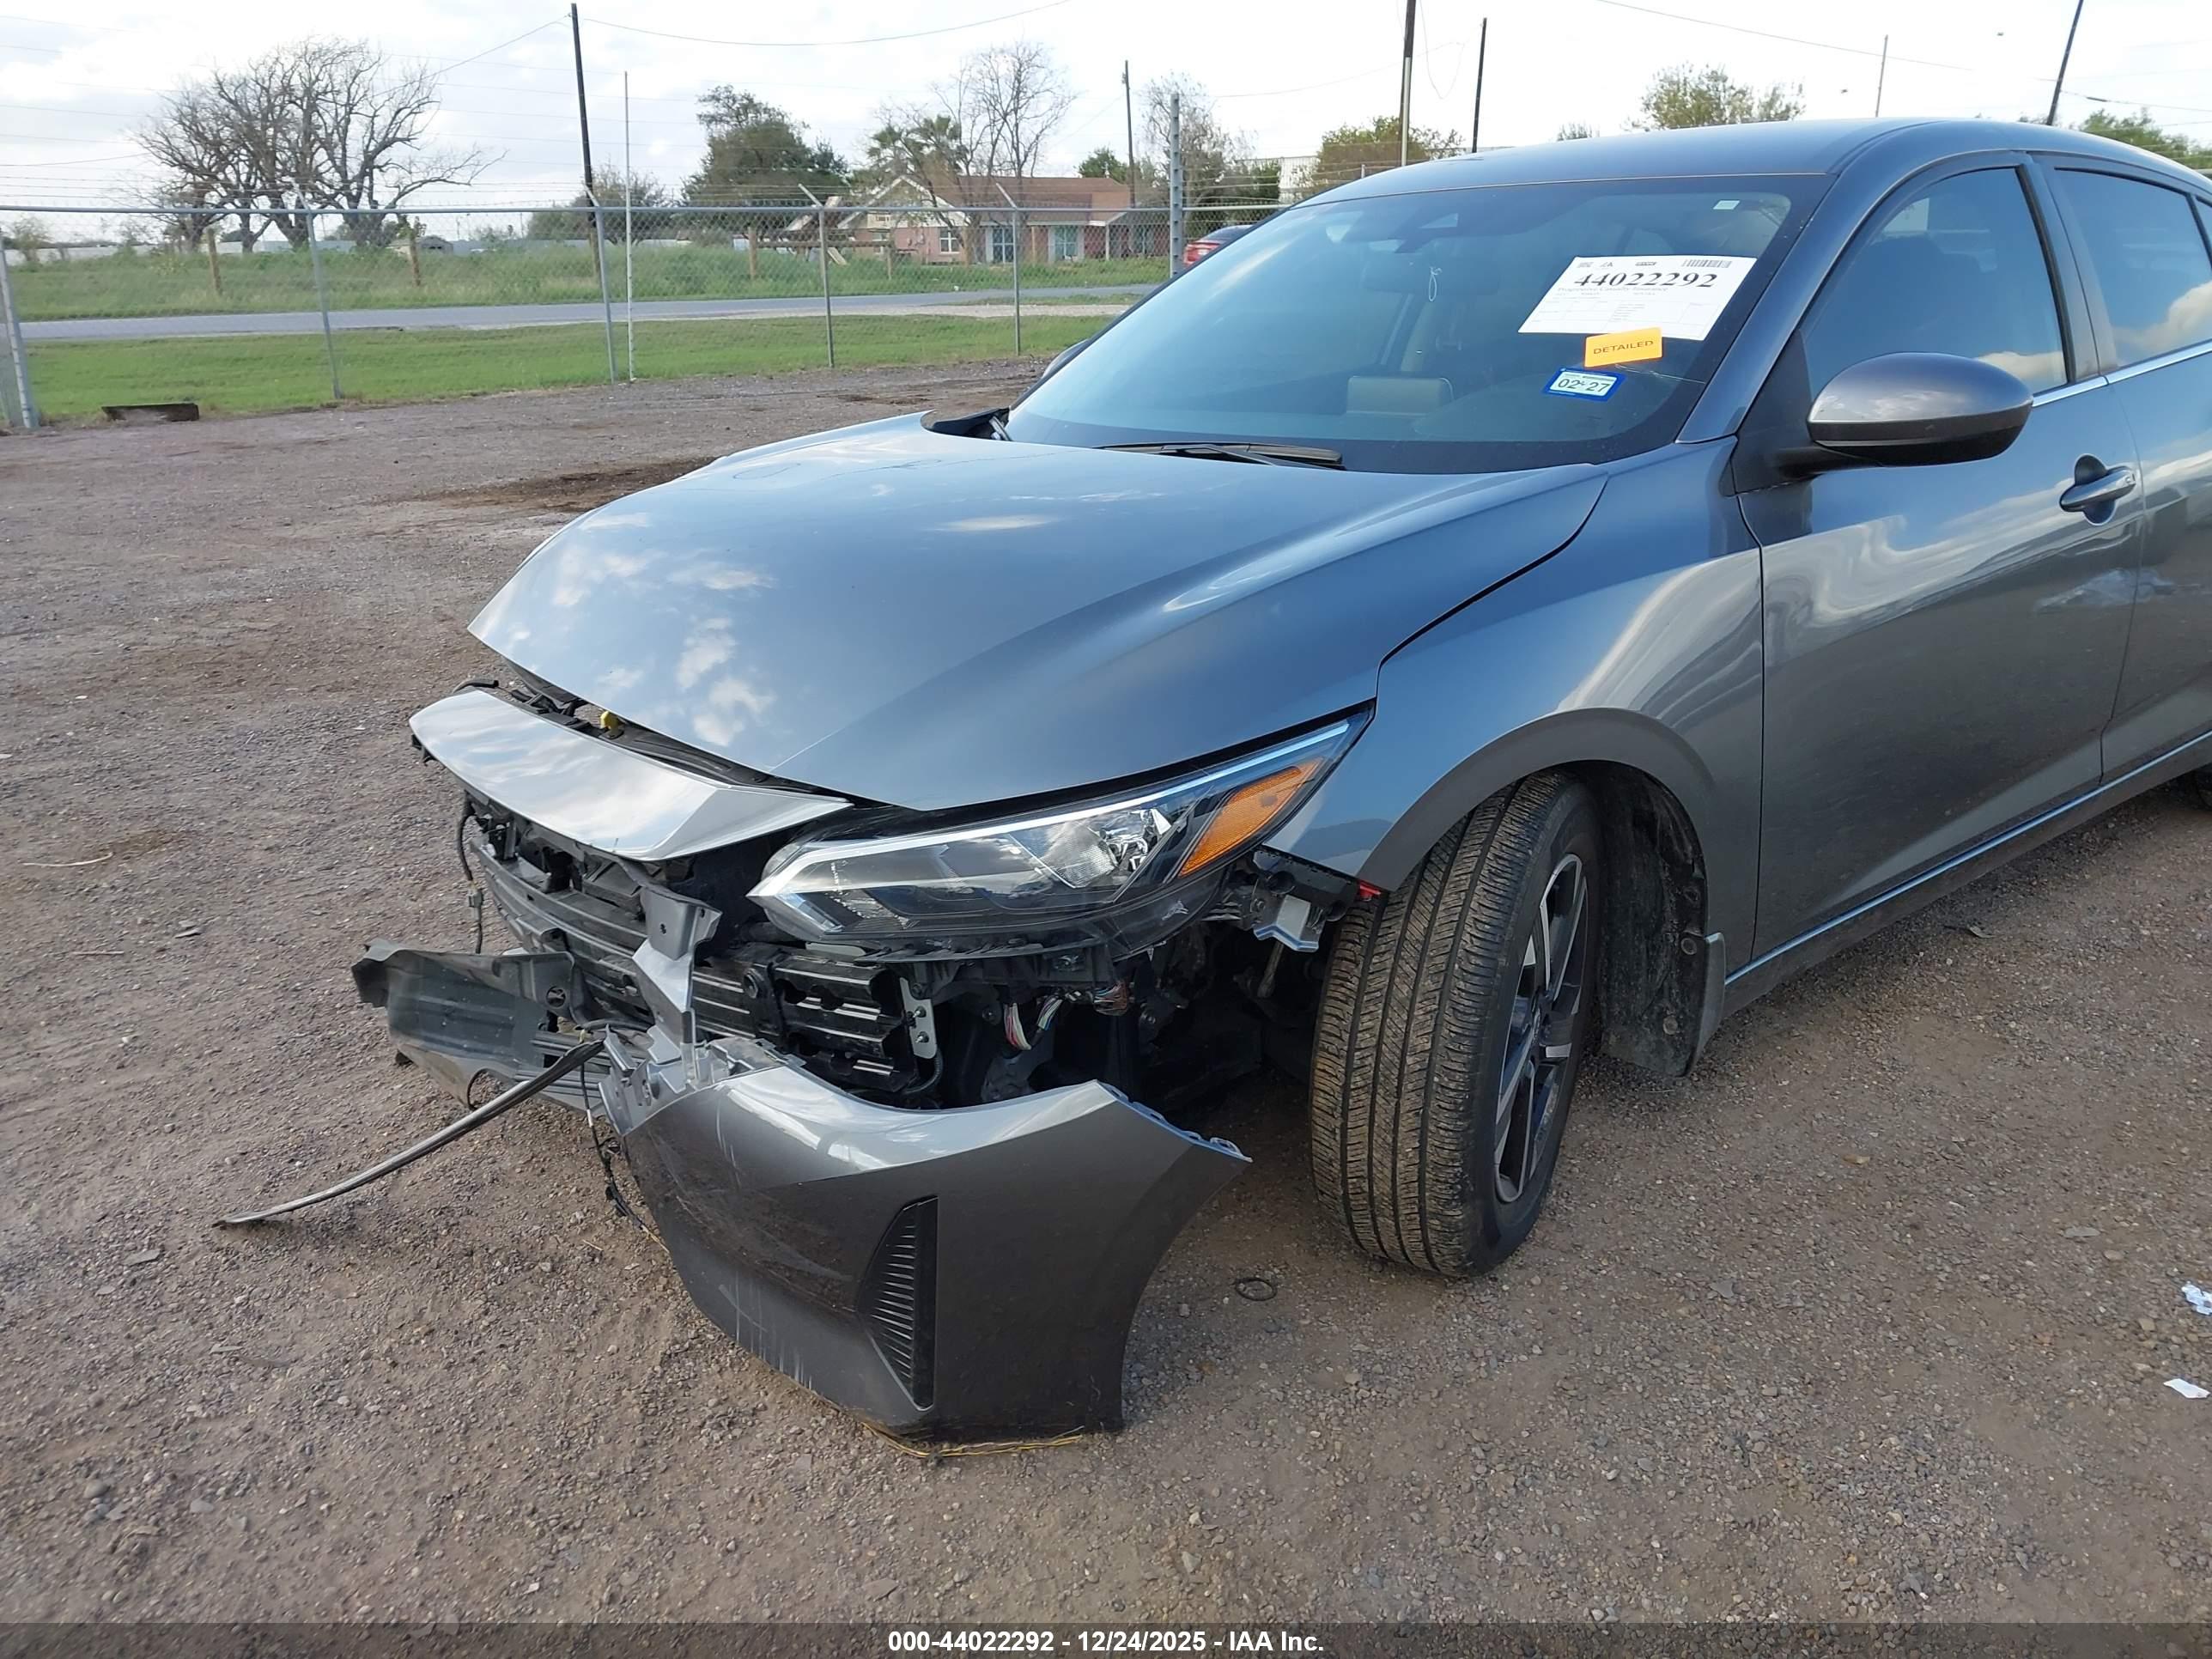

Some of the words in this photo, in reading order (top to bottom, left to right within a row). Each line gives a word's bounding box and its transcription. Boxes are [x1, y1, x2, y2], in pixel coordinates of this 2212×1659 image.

[1573, 272, 1717, 288] 44022292
[1593, 340, 1654, 355] DETAILED
[1558, 378, 1578, 389] 02
[1586, 381, 1610, 392] 27
